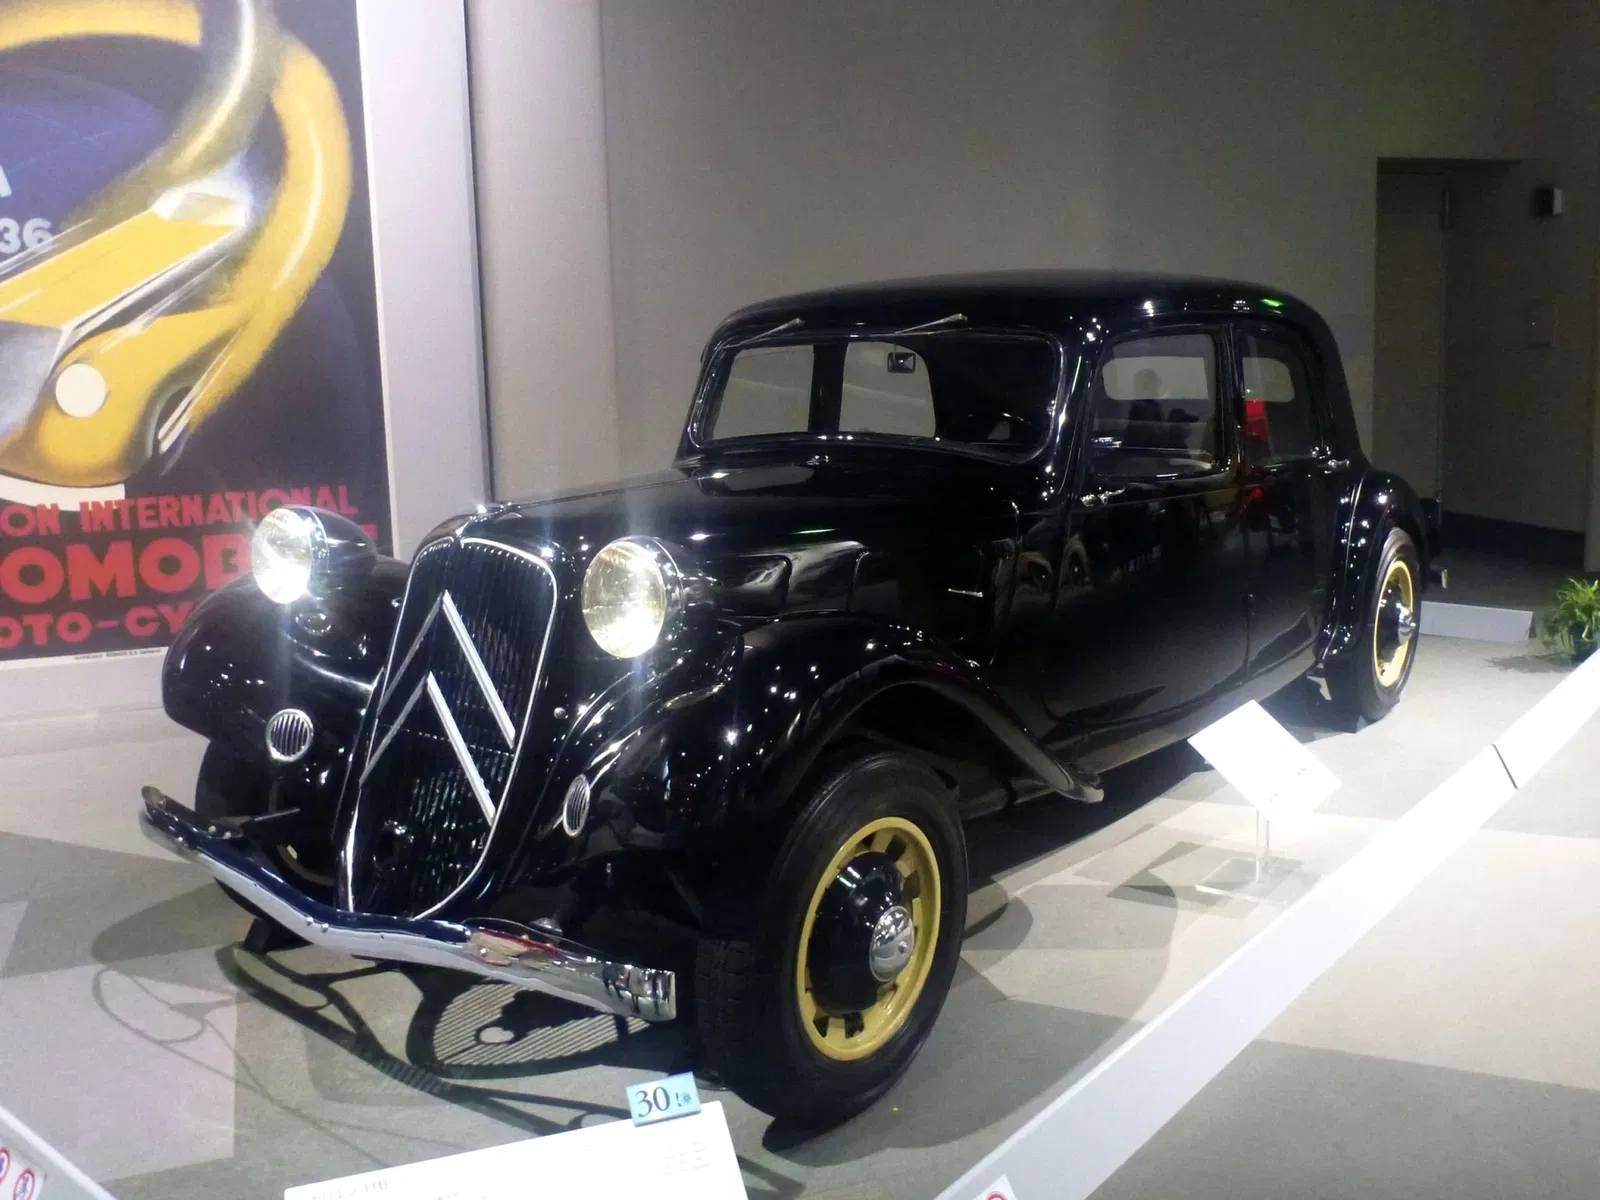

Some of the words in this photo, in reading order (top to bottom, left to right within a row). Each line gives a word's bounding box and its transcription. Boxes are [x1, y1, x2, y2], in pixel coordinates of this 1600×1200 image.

[79, 484, 358, 533] INTERNATIONAL
[0, 523, 377, 605] OMOB
[634, 1086, 670, 1118] 30
